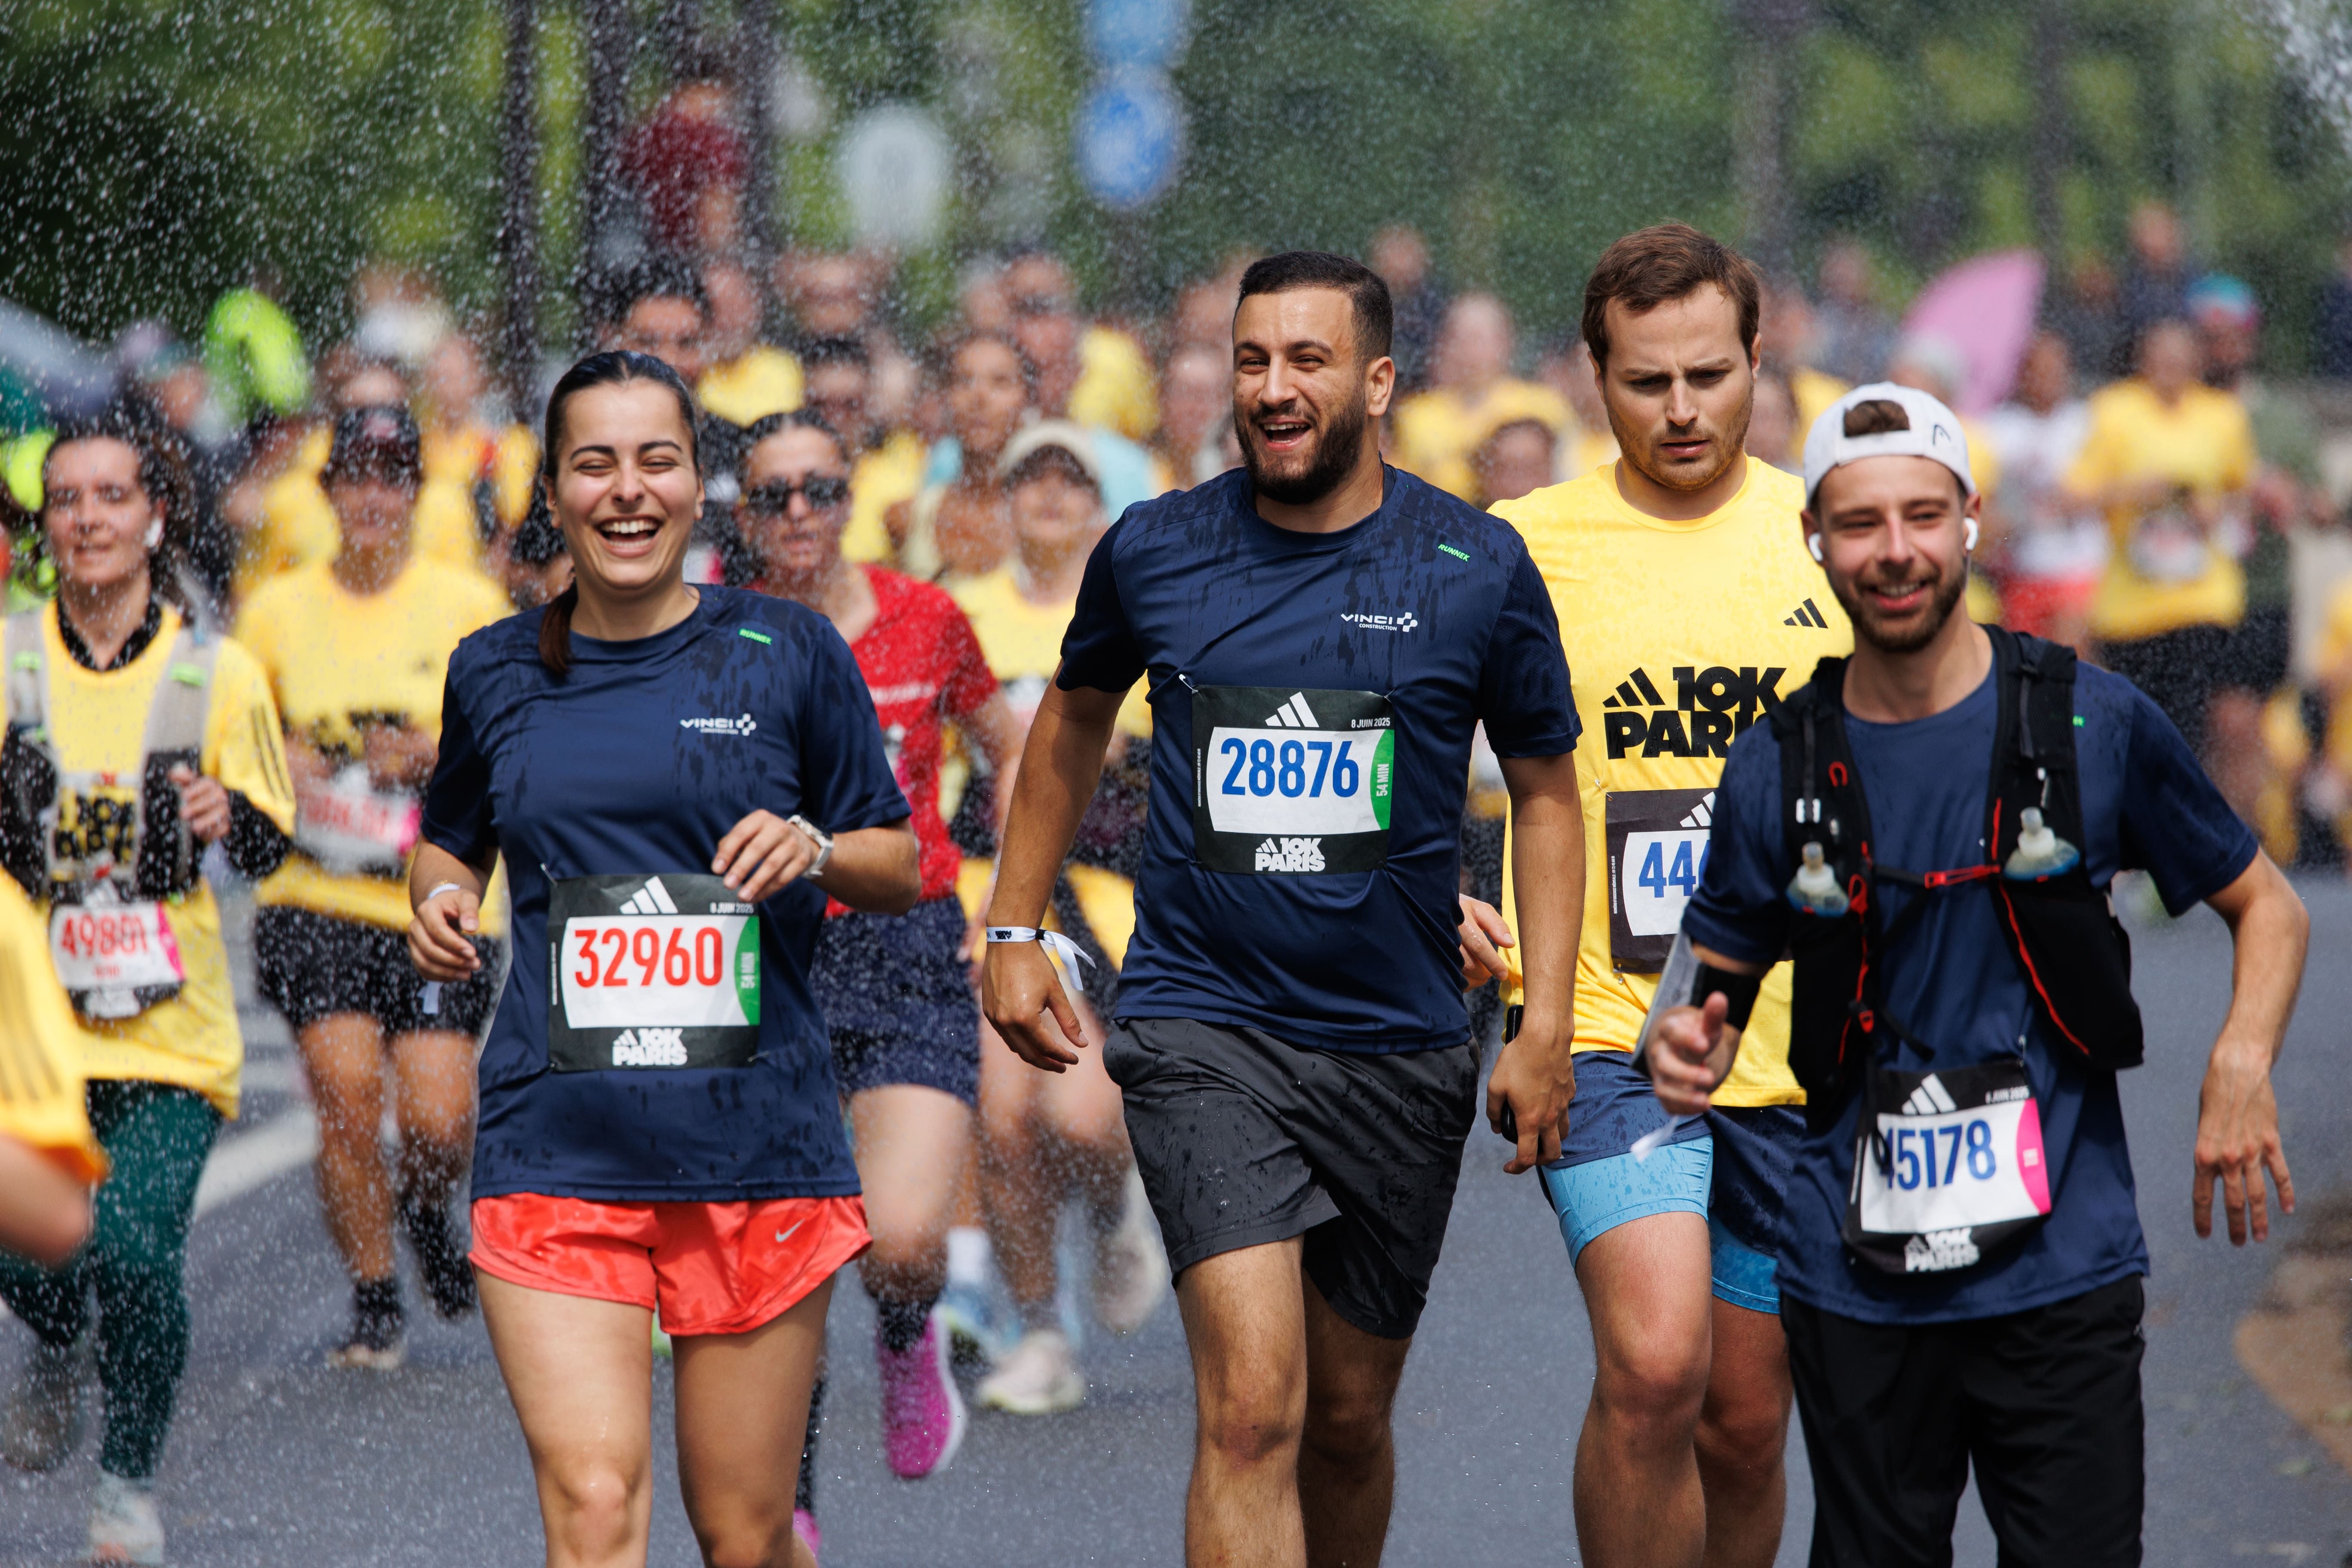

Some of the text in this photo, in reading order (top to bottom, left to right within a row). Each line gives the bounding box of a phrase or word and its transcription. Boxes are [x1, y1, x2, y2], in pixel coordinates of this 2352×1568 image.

[1438, 544, 1470, 561] RUNNEK
[1341, 613, 1393, 625] VINCI
[1672, 666, 1787, 712] 10K
[680, 718, 733, 729] VINCI
[1351, 717, 1390, 728] 8 JUIN 2025
[1604, 710, 1769, 760] PAR
[1221, 738, 1359, 798] 28876
[1376, 764, 1389, 797] 54 MIN
[1280, 838, 1322, 855] 10K
[1255, 853, 1325, 872] PARIS
[1638, 839, 1711, 898] 44
[574, 927, 723, 988] 32960
[638, 1028, 683, 1046] 10K
[612, 1045, 687, 1066] PARIS
